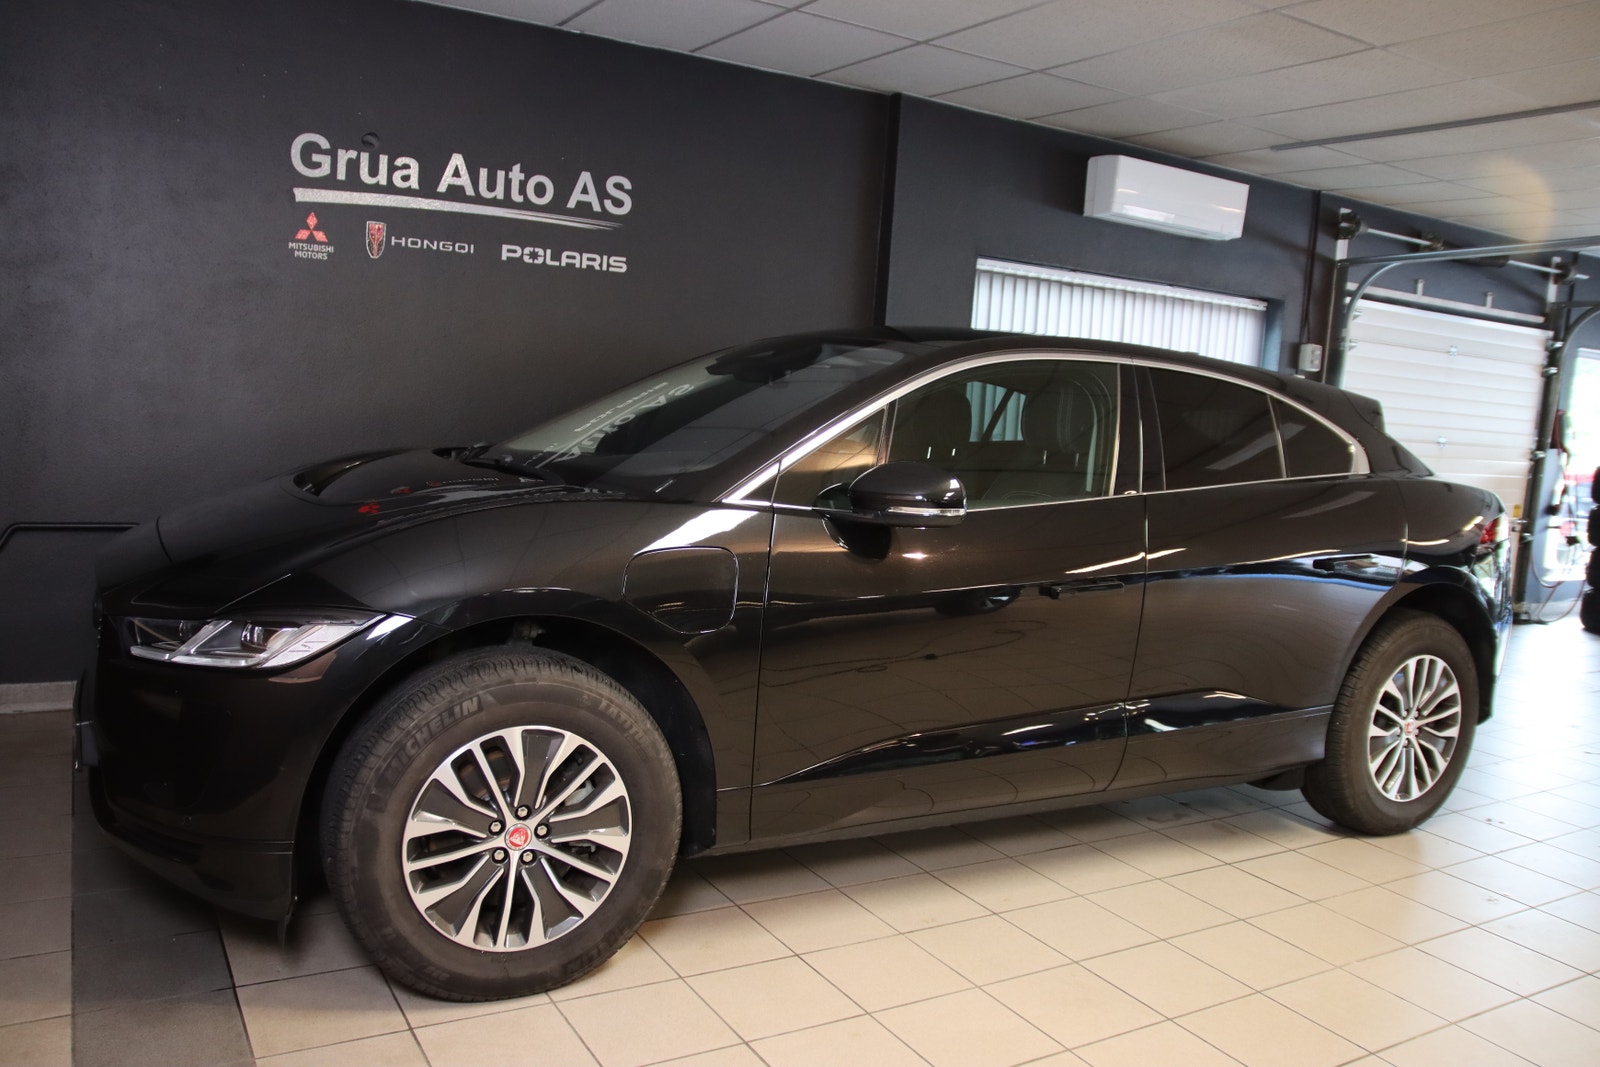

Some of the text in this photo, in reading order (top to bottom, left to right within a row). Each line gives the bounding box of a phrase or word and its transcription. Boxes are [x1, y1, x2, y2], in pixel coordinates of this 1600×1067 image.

[290, 132, 633, 216] Grua Auto AS
[288, 241, 335, 254] MITSUBISHI
[391, 236, 475, 254] HONGQI
[294, 250, 328, 261] MOTORS
[501, 243, 628, 273] POLARIS
